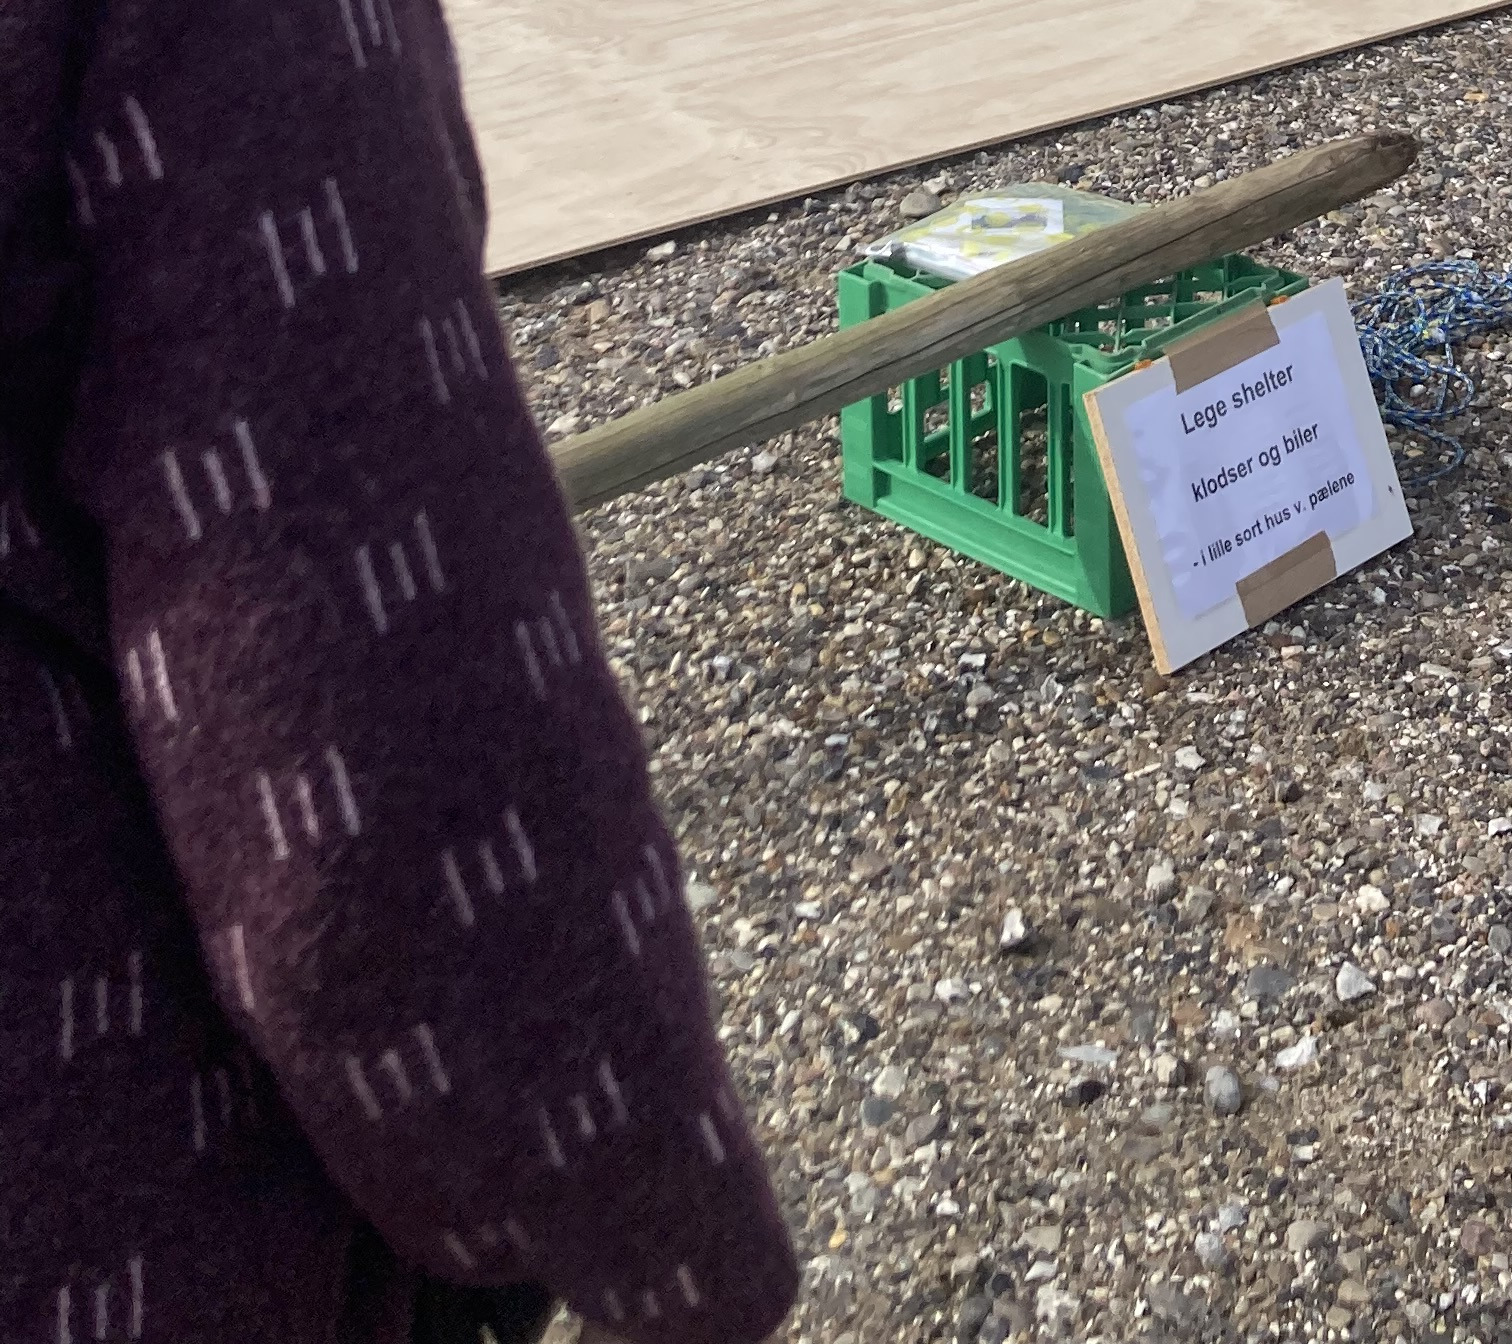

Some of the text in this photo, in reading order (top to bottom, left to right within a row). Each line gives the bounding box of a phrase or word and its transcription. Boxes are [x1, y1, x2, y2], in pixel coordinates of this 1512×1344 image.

[1180, 364, 1294, 435] Lege shelter
[1191, 423, 1319, 503] klodser og biler
[1207, 538, 1233, 562] lille
[1235, 519, 1264, 547] sort
[1263, 507, 1292, 531] hus
[1293, 500, 1307, 514] v.
[1308, 471, 1356, 511] pælene
